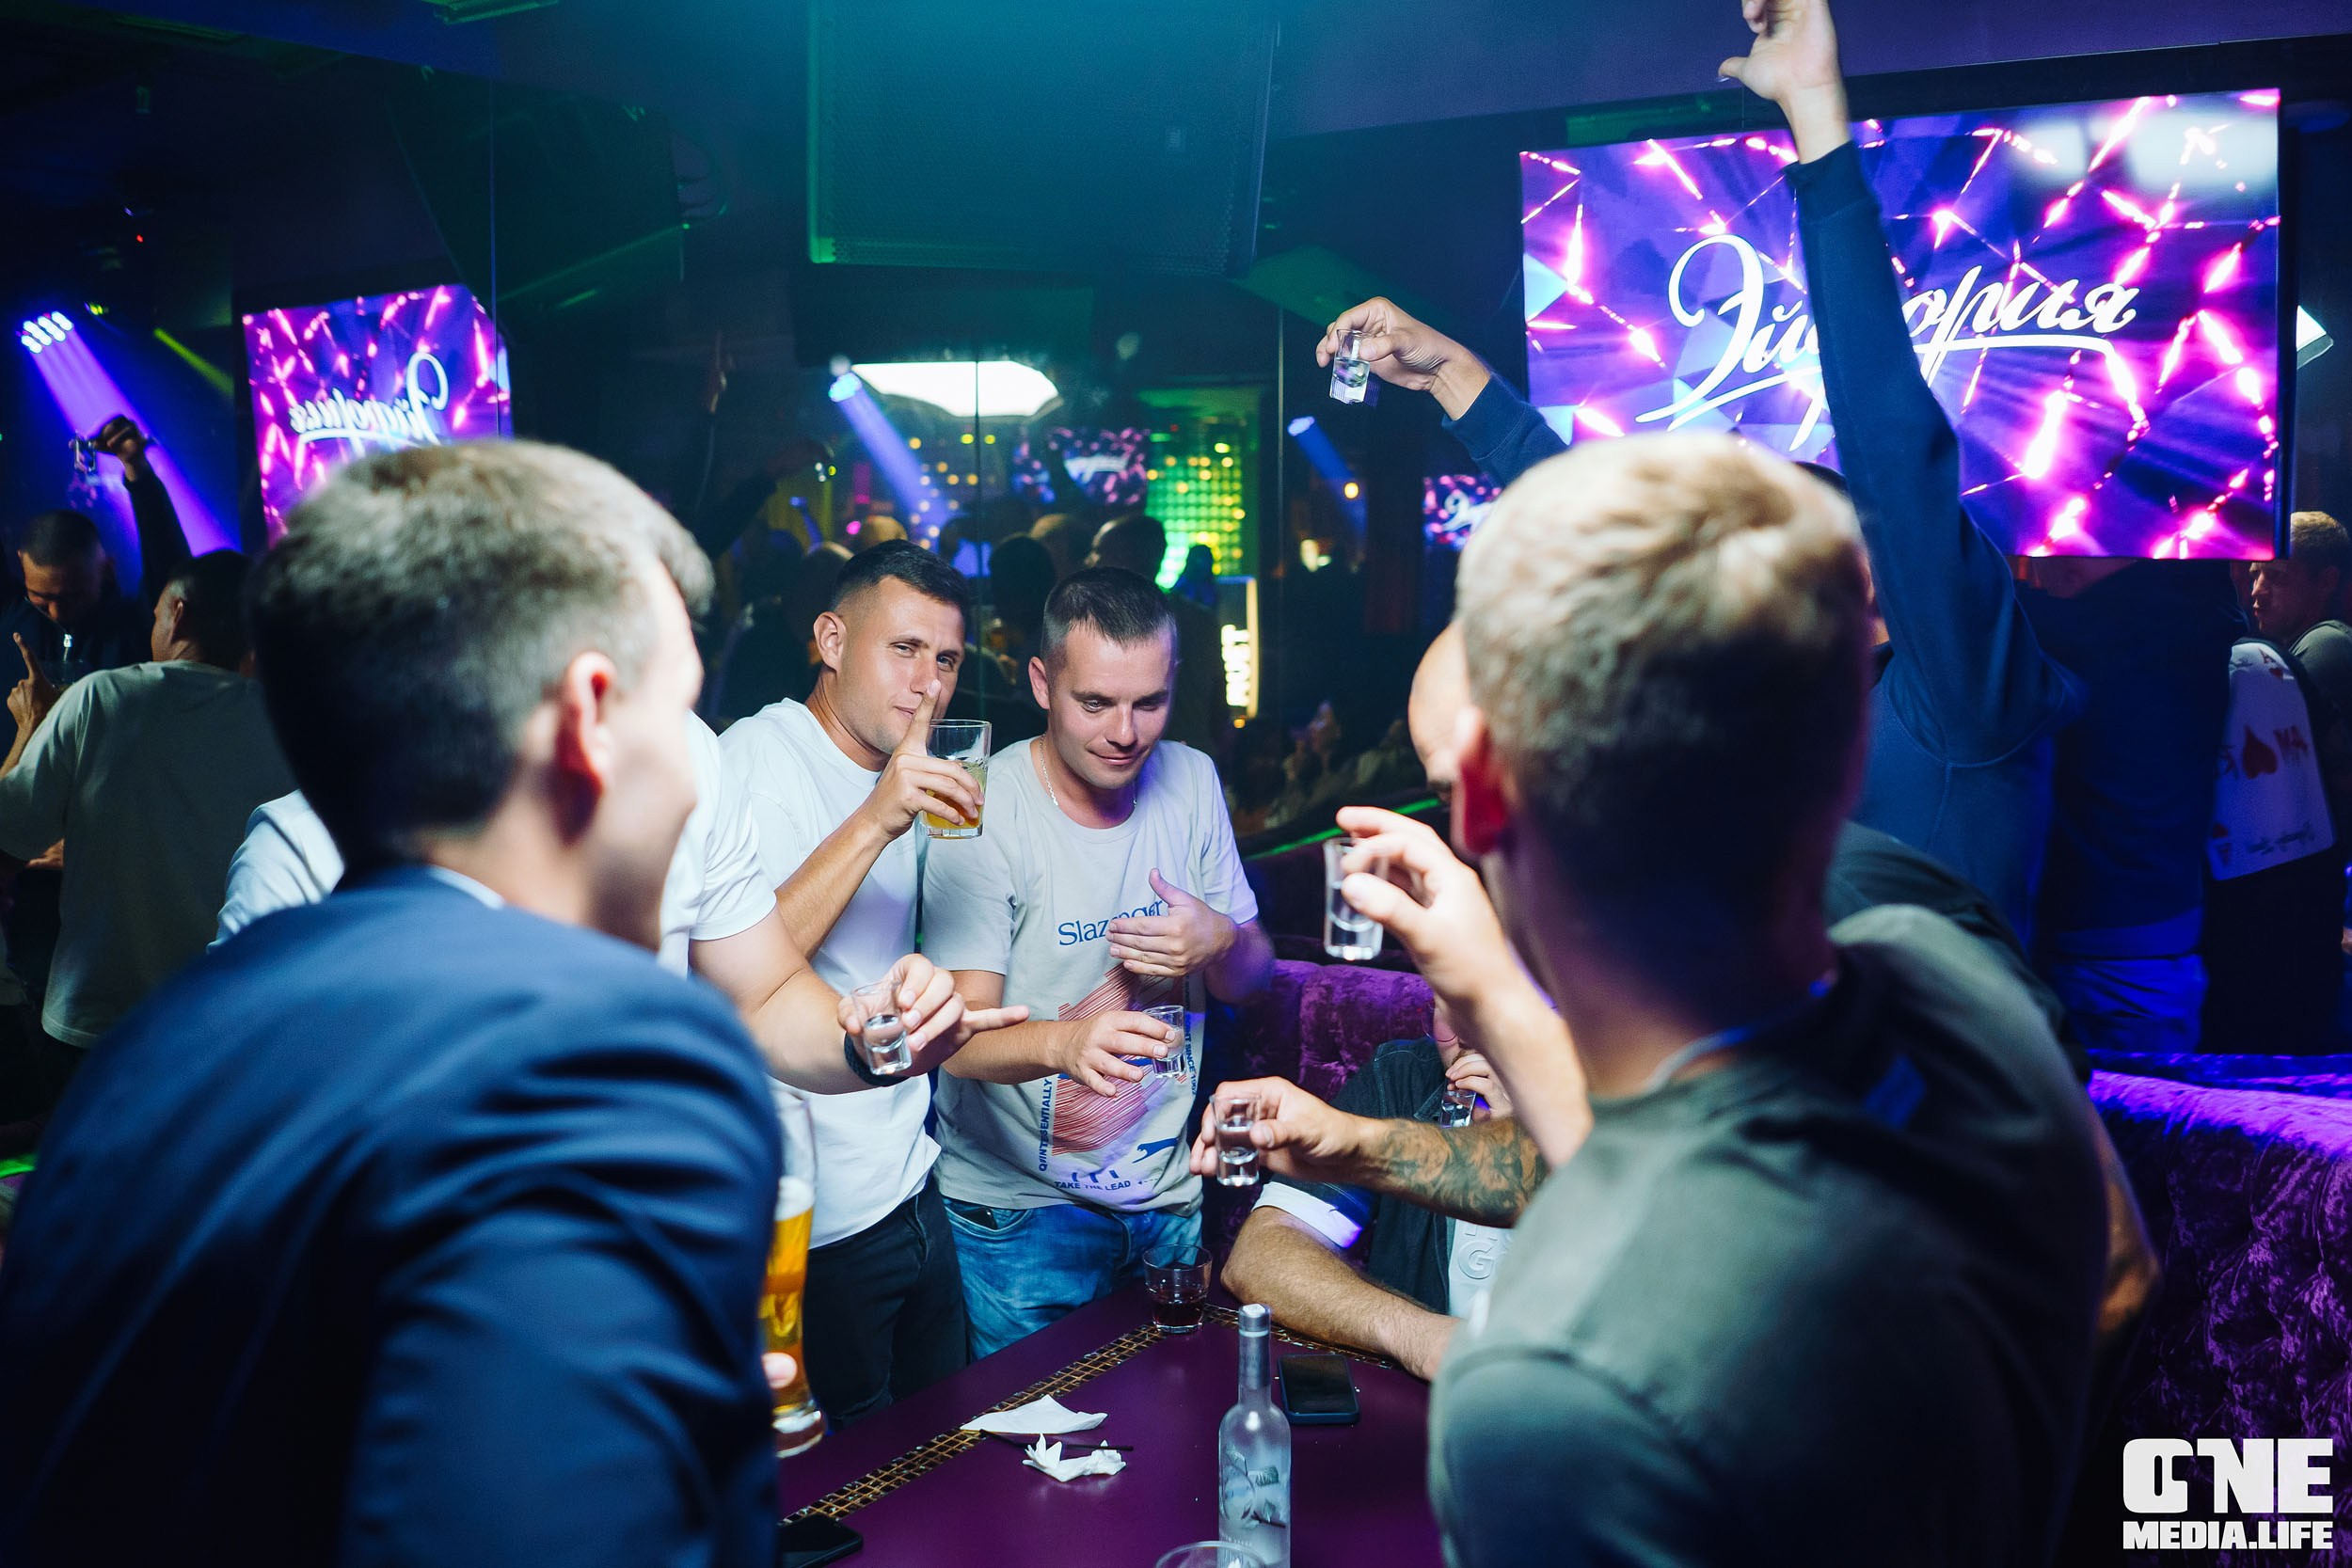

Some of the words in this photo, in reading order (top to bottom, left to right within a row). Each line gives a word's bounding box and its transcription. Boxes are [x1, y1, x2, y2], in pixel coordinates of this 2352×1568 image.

[1635, 234, 2139, 451] Эйория
[1054, 1180, 1081, 1190] TAKE
[1104, 1180, 1131, 1191] LEAD
